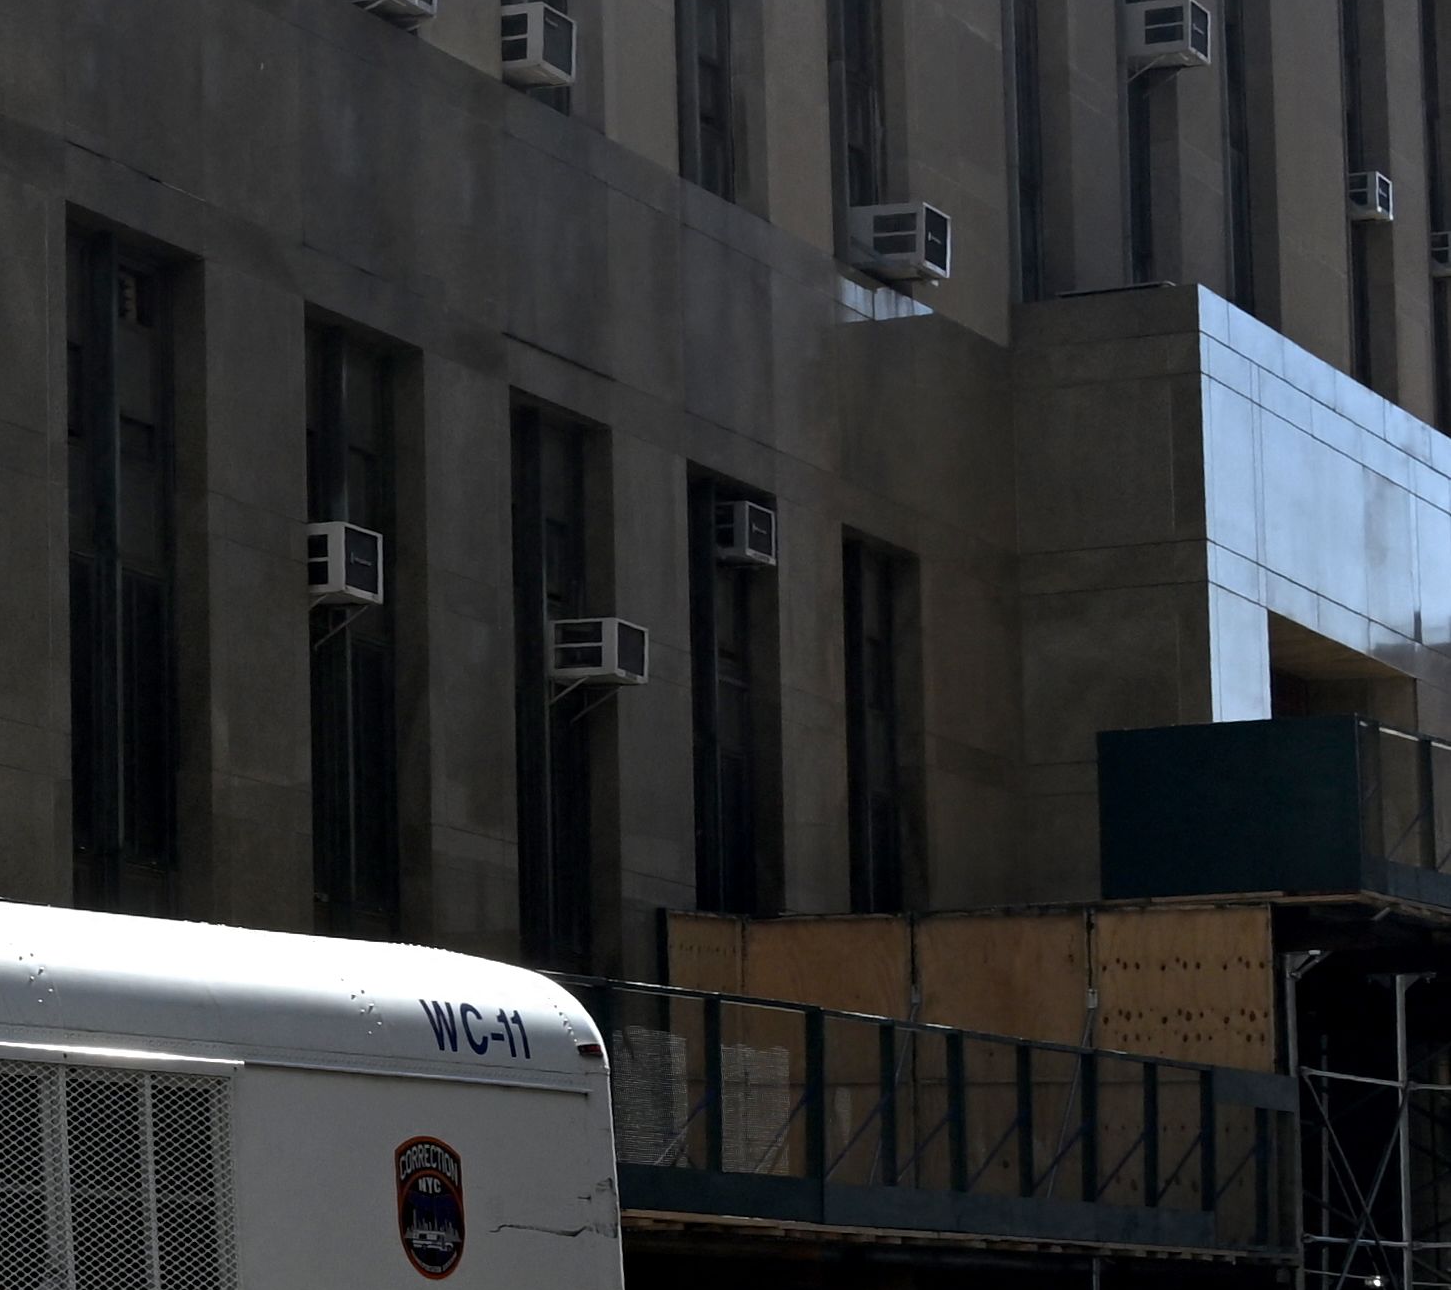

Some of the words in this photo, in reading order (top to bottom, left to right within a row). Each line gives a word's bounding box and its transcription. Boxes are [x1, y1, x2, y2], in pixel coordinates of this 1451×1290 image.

[419, 998, 531, 1059] WC-11
[399, 1143, 459, 1188] CORRECTION
[417, 1176, 442, 1194] NYC
